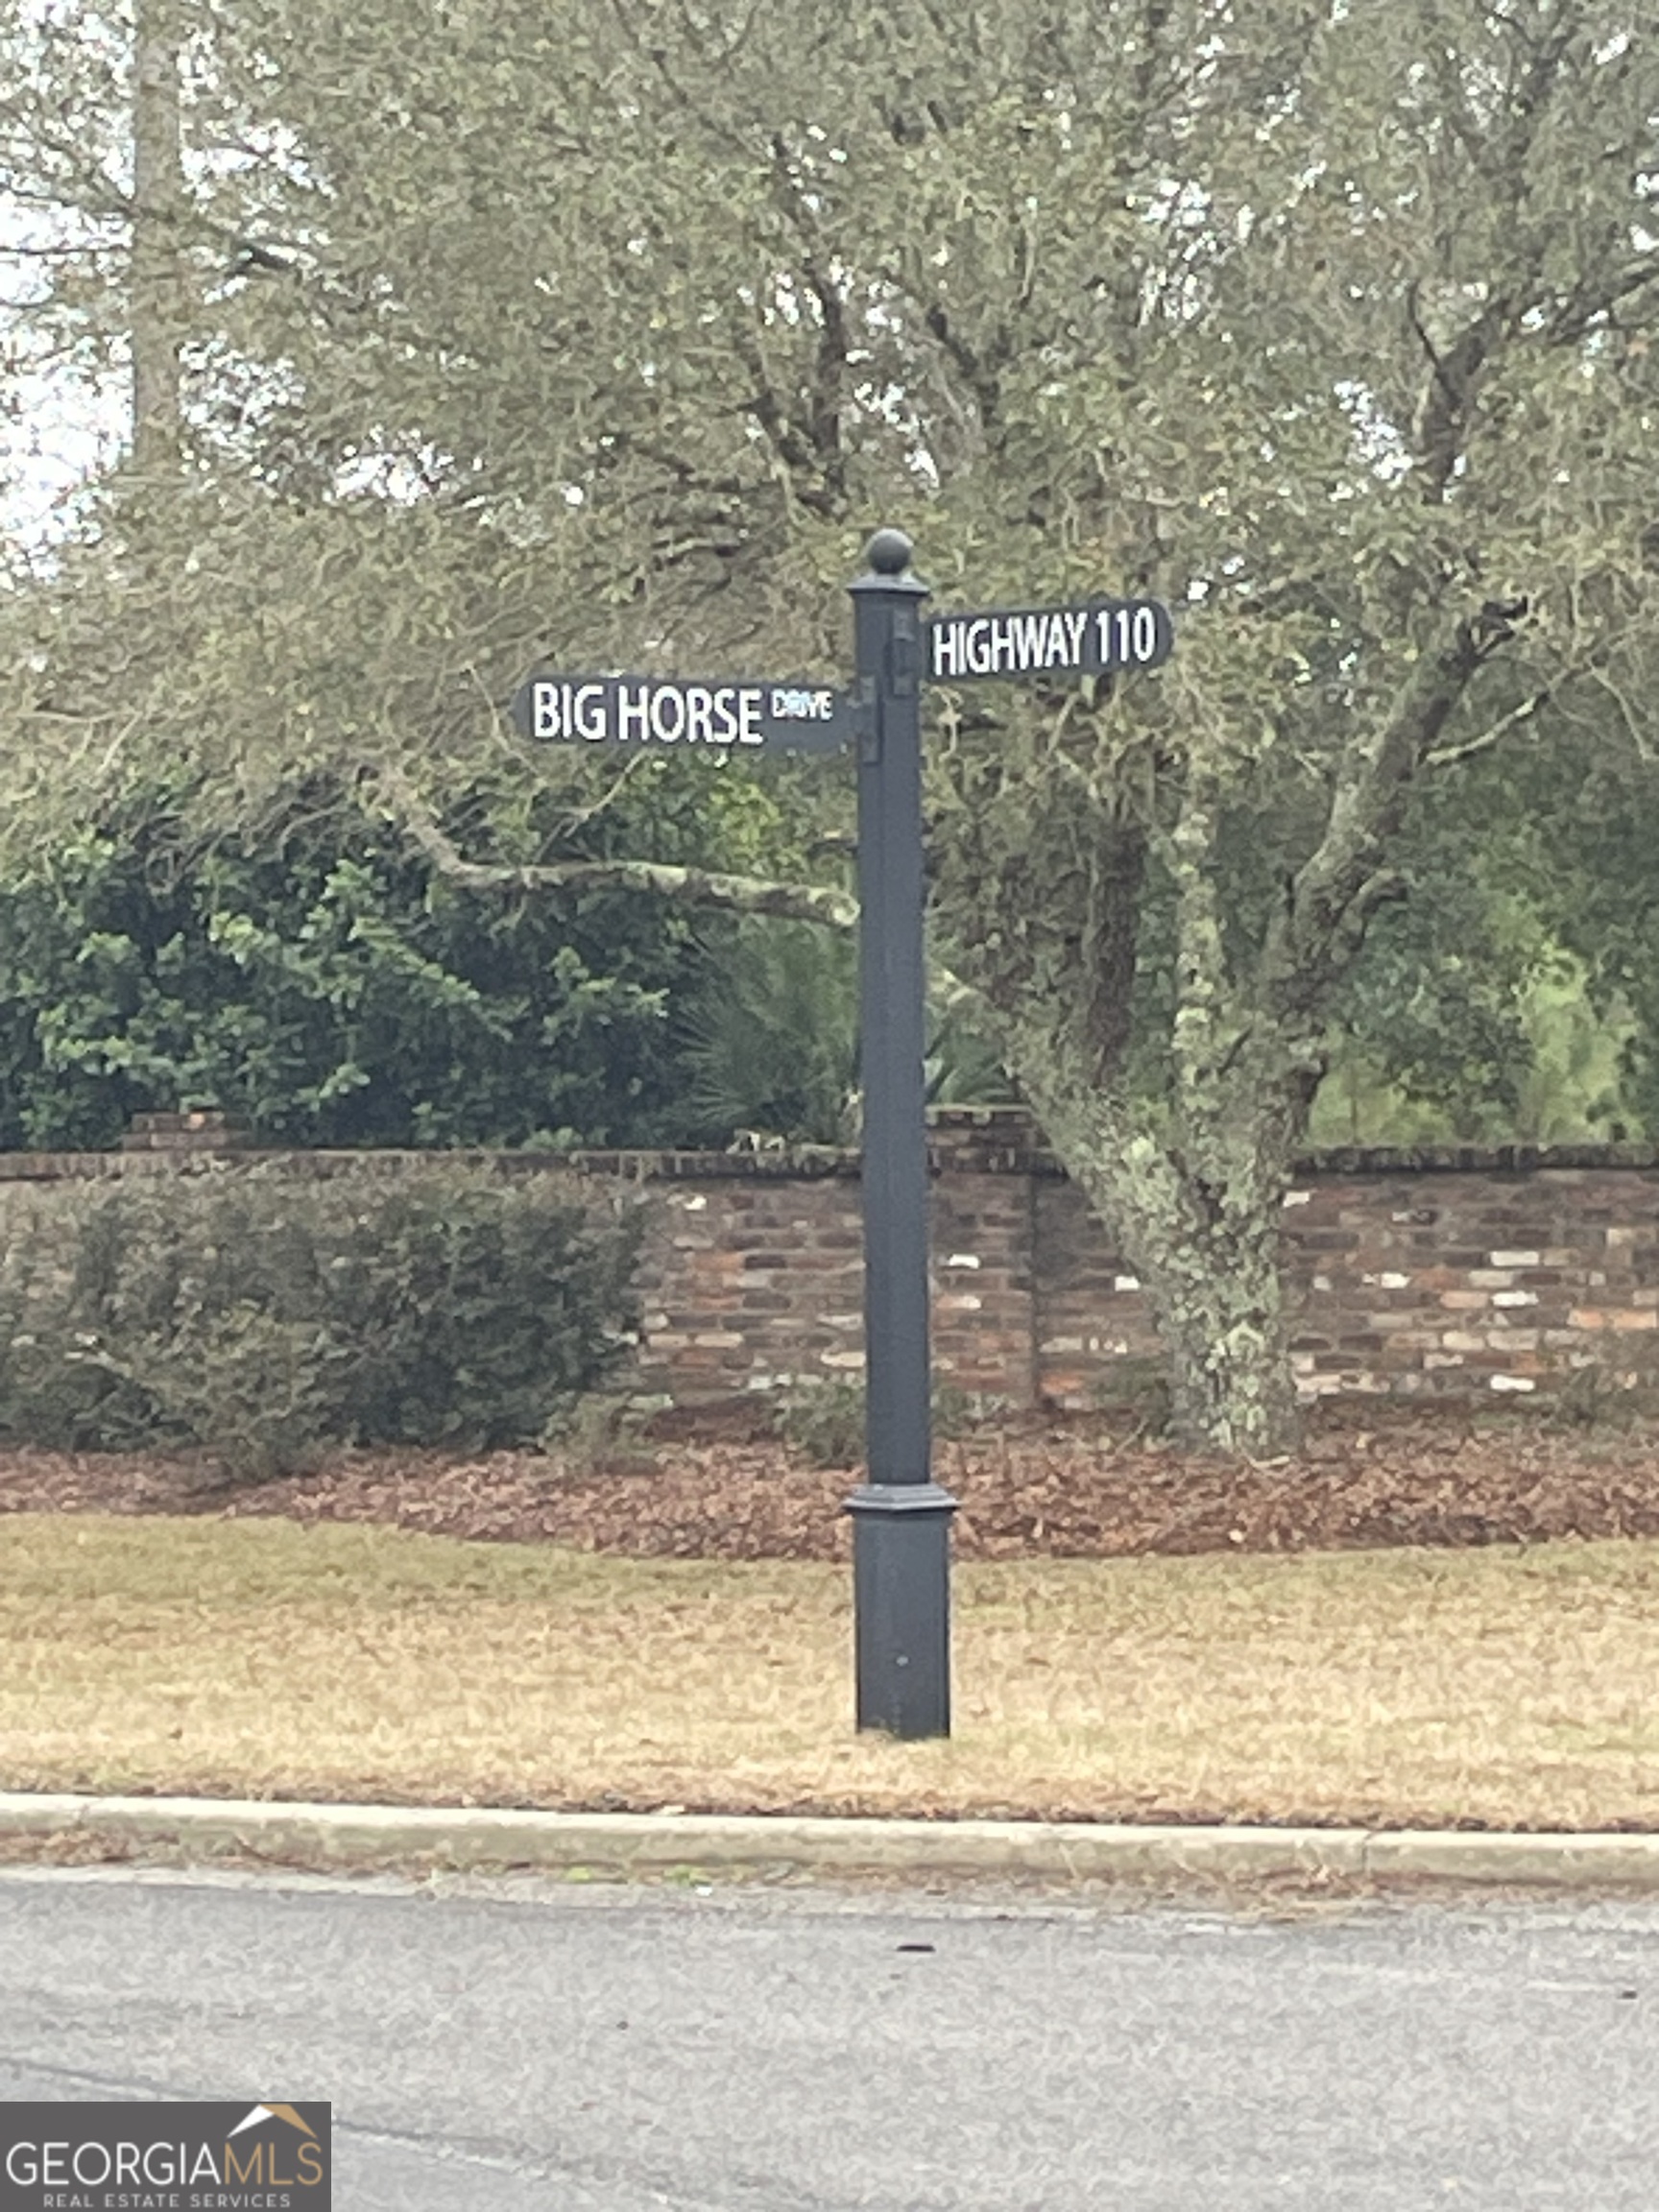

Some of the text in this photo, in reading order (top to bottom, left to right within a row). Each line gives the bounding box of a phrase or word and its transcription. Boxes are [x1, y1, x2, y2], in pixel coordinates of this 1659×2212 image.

[932, 606, 1156, 676] HIGHWAY 110
[532, 681, 605, 741] BIG
[617, 685, 763, 744] HORSE
